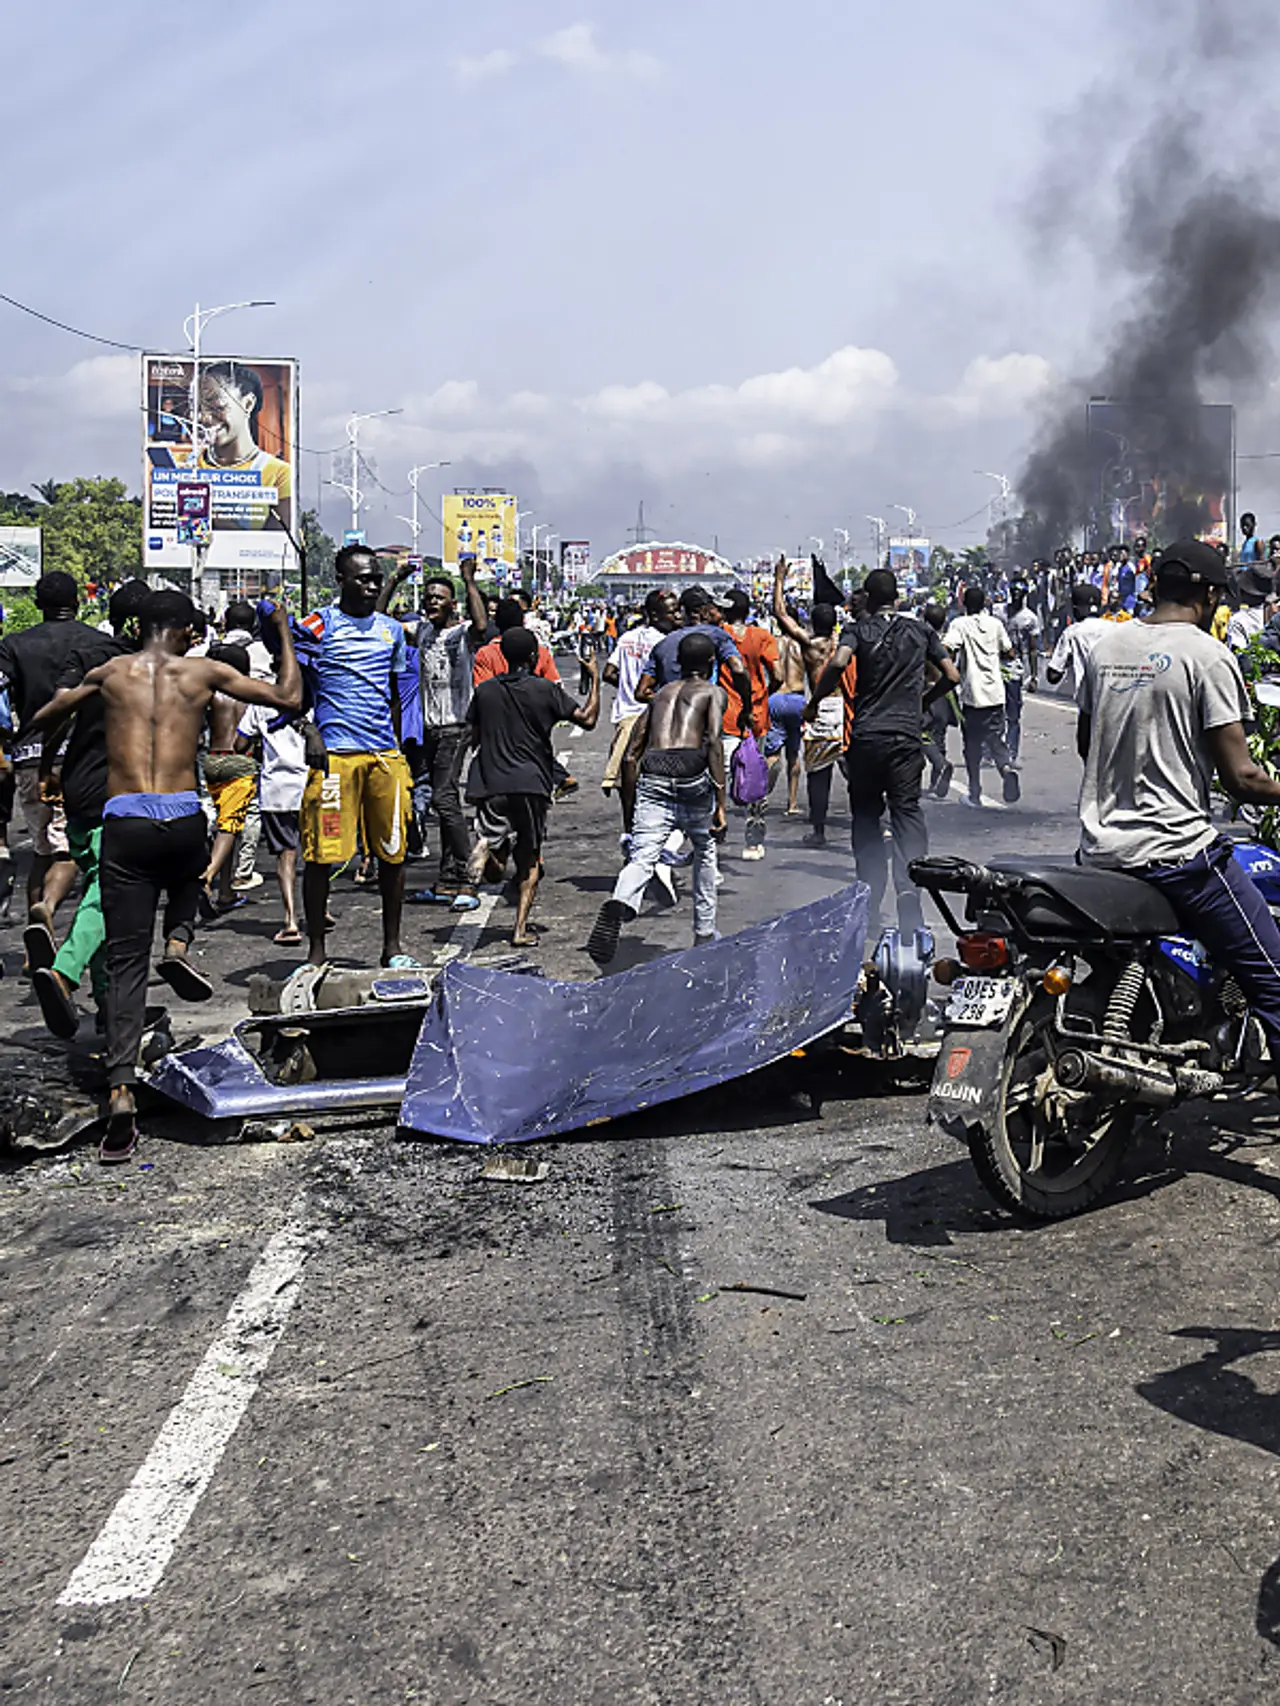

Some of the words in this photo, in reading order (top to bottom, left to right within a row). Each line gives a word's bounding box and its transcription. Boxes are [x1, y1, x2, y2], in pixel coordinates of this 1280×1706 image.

[153, 470, 170, 482] UN
[222, 472, 257, 485] CHOIX
[213, 489, 277, 501] TRANSFERTS
[463, 497, 496, 508] 100%
